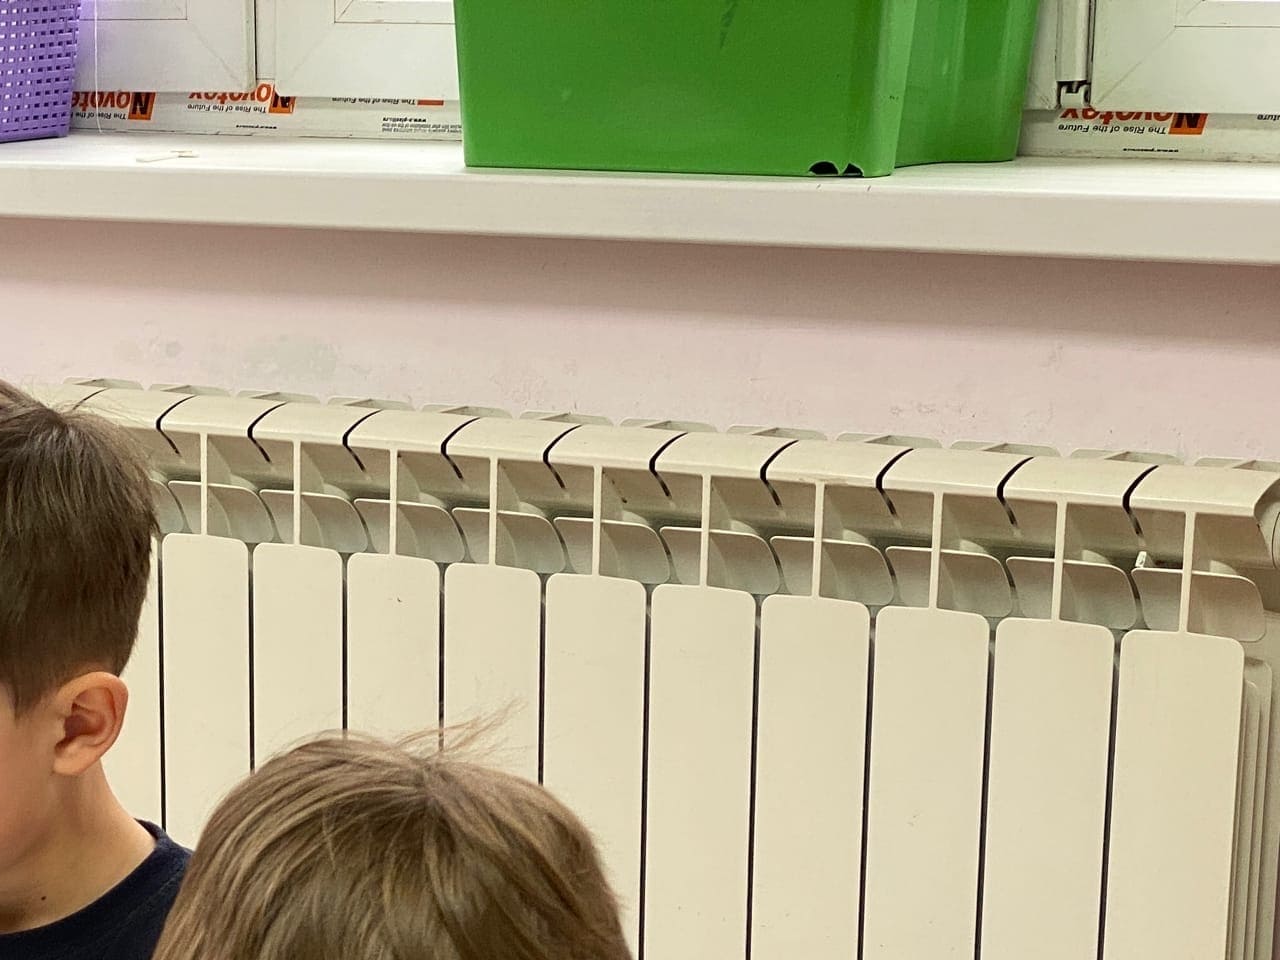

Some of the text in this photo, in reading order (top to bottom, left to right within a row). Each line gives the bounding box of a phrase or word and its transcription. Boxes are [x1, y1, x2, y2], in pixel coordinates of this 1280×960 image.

[72, 92, 150, 114] Novote
[212, 104, 224, 112] the
[253, 106, 266, 114] The
[86, 112, 94, 120] of
[114, 112, 126, 120] The
[1058, 124, 1166, 134] The Rise of the Future
